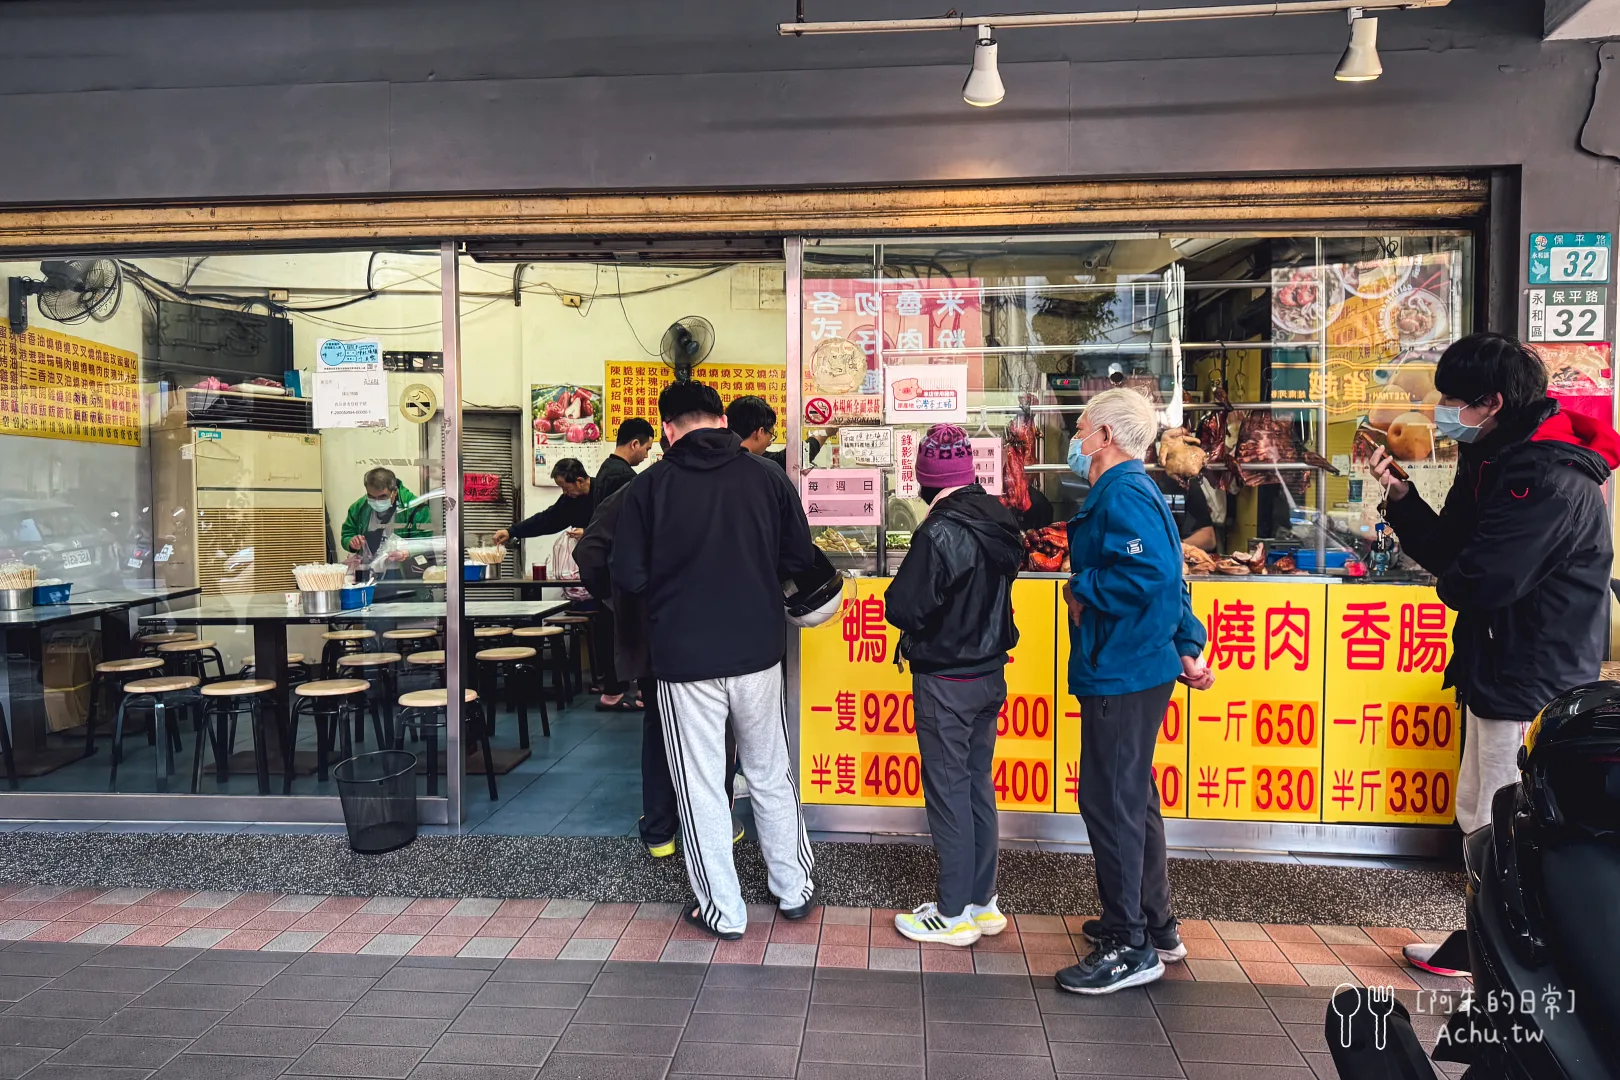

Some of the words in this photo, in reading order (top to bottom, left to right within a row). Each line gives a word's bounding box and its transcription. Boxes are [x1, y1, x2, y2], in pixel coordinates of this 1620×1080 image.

[1554, 235, 1606, 246] 保平路
[1563, 250, 1597, 277] 32
[1531, 293, 1543, 337] 永和區
[1553, 290, 1598, 304] 保平路
[1552, 309, 1597, 337] 32
[610, 366, 621, 426] 陳記招牌飯
[635, 366, 646, 418] 蜜汁烤雞腿
[536, 433, 548, 445] 12
[808, 480, 873, 492] 每週日
[901, 434, 913, 494] 錄影監視中
[808, 502, 873, 514] 公休
[842, 594, 887, 663] 鴨
[1206, 598, 1310, 672] 燒肉
[1341, 601, 1448, 674] 香腸
[811, 689, 857, 732] 一隻
[863, 693, 916, 734] 920
[1198, 701, 1248, 742] 一斤
[1255, 703, 1315, 746] 650
[1333, 703, 1384, 746] 一斤
[1390, 704, 1452, 748] 650
[810, 753, 857, 795] 半隻
[864, 755, 921, 796] 460
[993, 760, 1049, 803] 400
[1197, 765, 1246, 808] 半斤
[1255, 768, 1314, 811] 330
[1332, 768, 1382, 812] 半斤
[1389, 770, 1450, 814] 330
[1111, 964, 1128, 976] FILA
